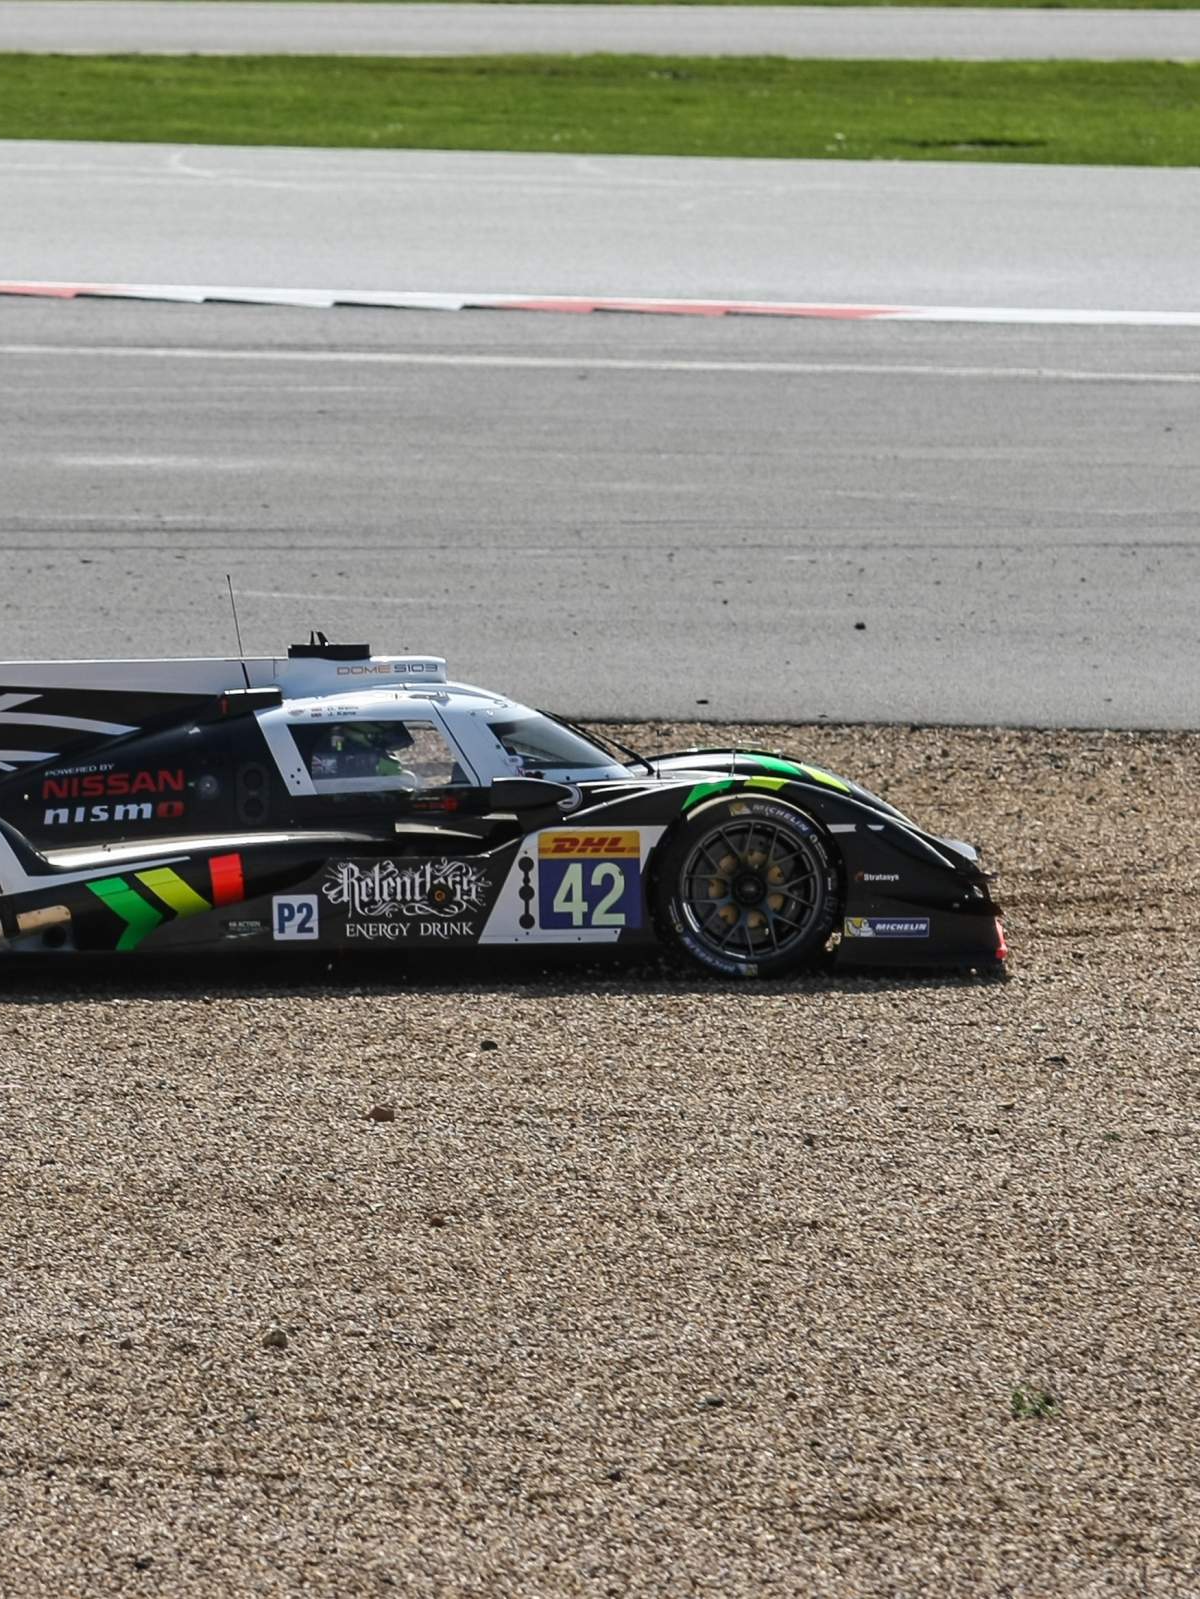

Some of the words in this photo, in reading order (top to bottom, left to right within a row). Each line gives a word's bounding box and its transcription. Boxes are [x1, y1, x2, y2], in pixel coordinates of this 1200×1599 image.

[337, 665, 391, 675] DOME
[394, 664, 437, 673] S103
[45, 765, 97, 776] POWERED
[100, 763, 115, 771] BY
[42, 769, 185, 799] NISSAN
[44, 801, 185, 825] nismo
[552, 837, 626, 853] DHL
[864, 873, 899, 882] Stratasys
[553, 862, 626, 926] 42
[277, 902, 314, 934] P2
[346, 922, 411, 941] ENERGY
[420, 922, 475, 940] DRINK
[876, 923, 928, 931] MICHELIN
